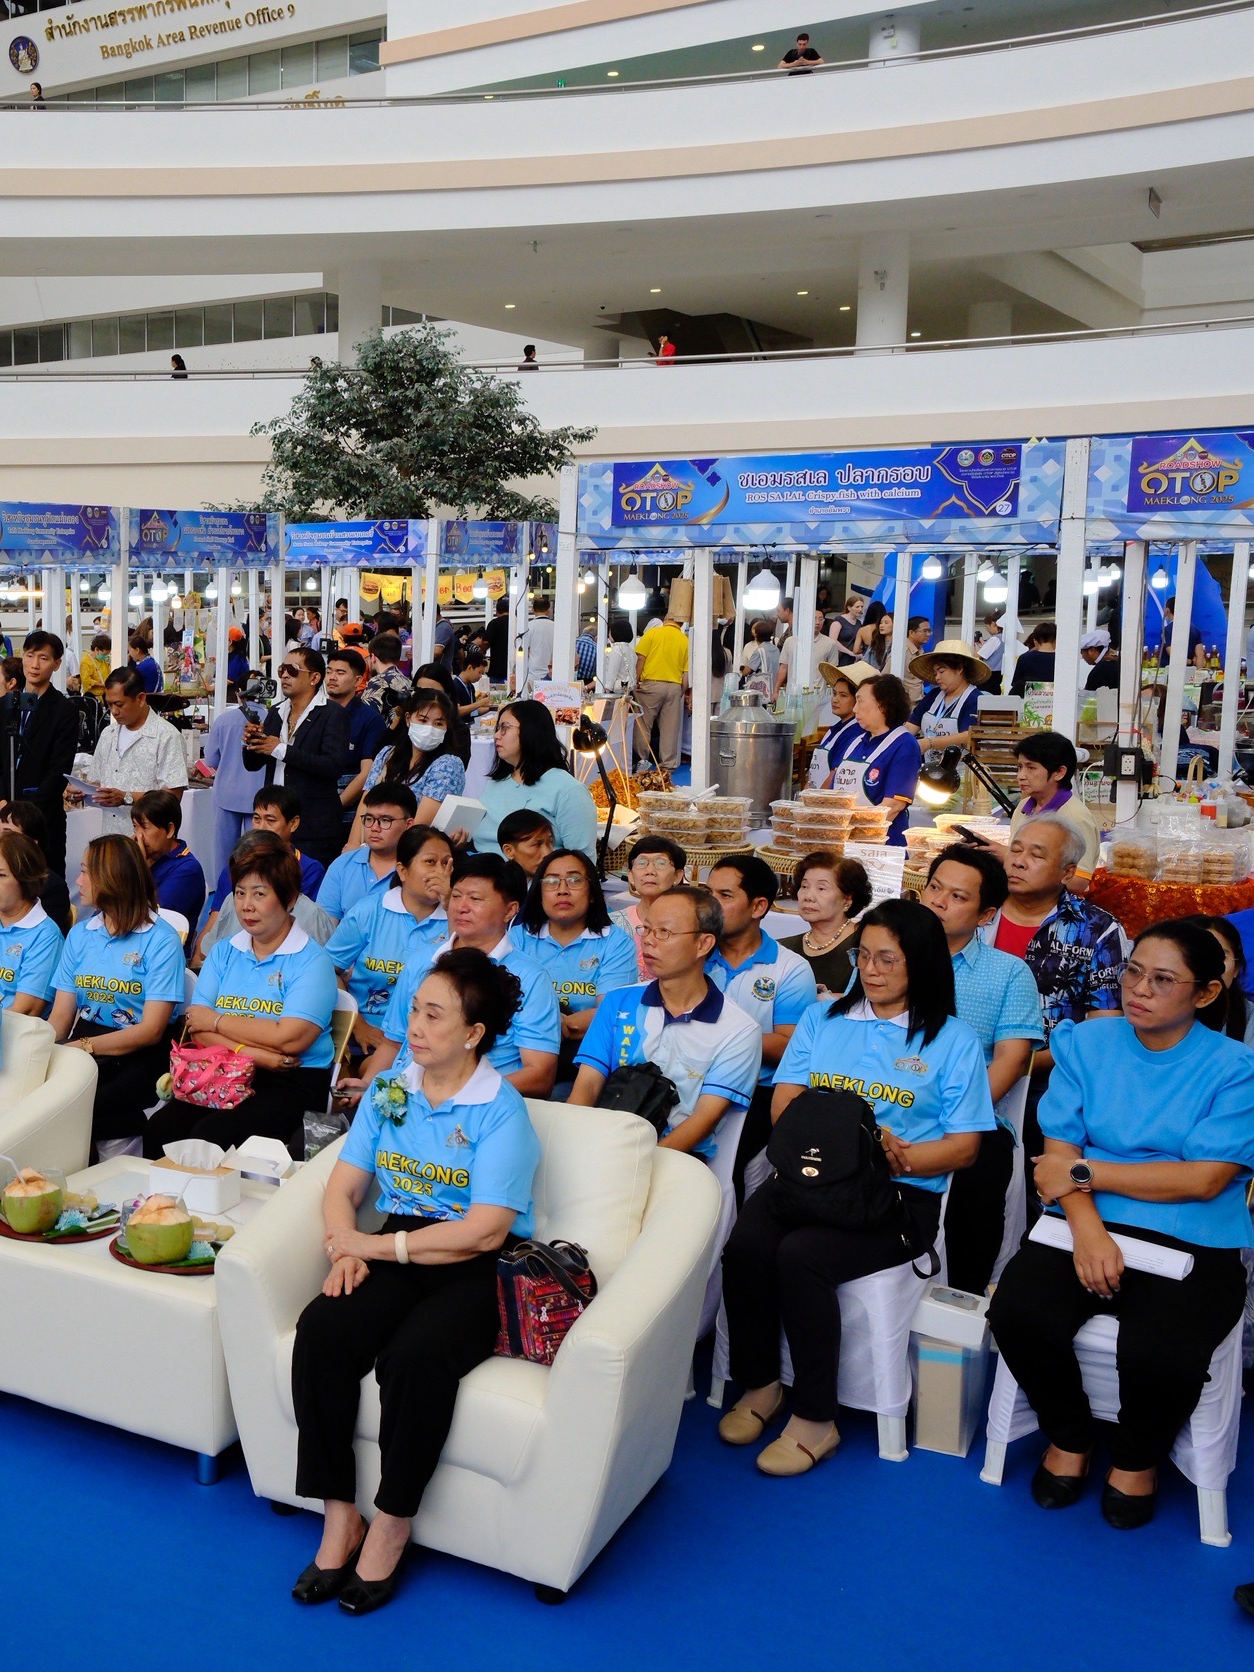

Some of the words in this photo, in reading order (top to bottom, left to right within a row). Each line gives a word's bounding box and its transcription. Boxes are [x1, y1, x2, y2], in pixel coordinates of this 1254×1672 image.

[100, 36, 152, 59] Bangkok
[157, 30, 185, 48] Area
[188, 17, 242, 40] Revenue
[244, 7, 285, 26] Office
[287, 3, 296, 18] 9
[836, 463, 932, 484] ปลากรอบ
[1159, 460, 1221, 470] ROADSHOW
[634, 481, 679, 490] ROADSHOW
[1141, 470, 1239, 495] OTOP
[621, 490, 693, 512] OTOP
[747, 494, 767, 502] ROS
[768, 493, 783, 501] SA
[859, 489, 881, 499] with
[883, 488, 921, 498] calcium
[1144, 495, 1207, 505] MAEKLONG
[1210, 495, 1234, 504] 2025
[624, 512, 670, 520] MAEKLONG
[998, 504, 1010, 512] 27
[86, 991, 115, 1004] 2025
[215, 996, 283, 1015] AEKLONG
[810, 1072, 916, 1109] MAEKLONG
[376, 1149, 469, 1188] AEKLONG
[392, 1175, 433, 1198] 2025
